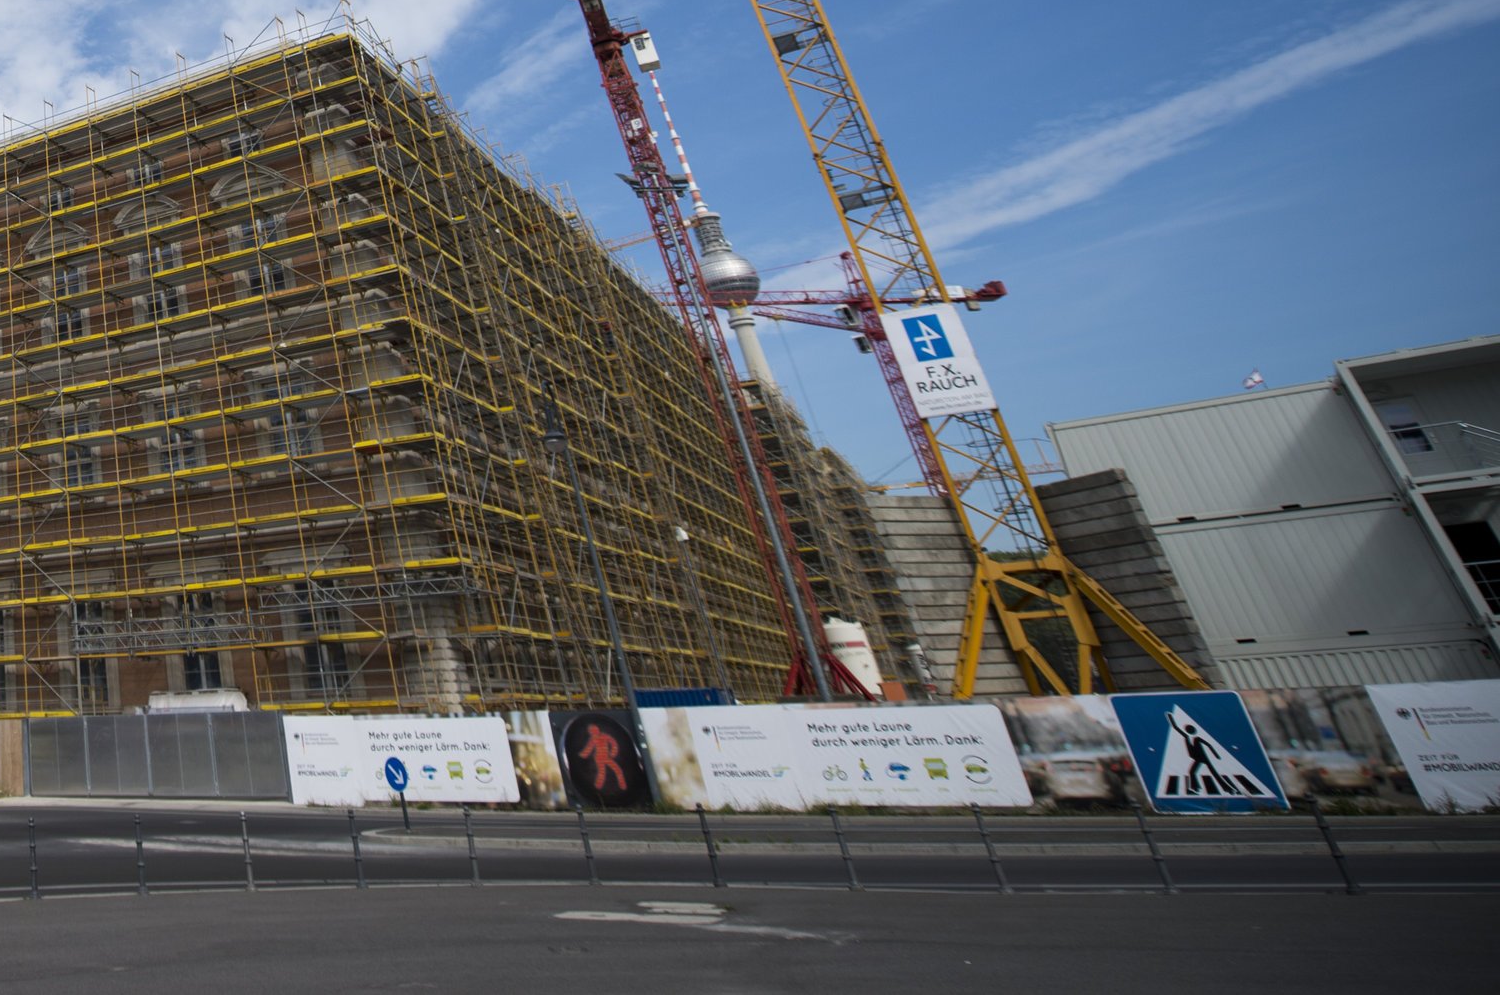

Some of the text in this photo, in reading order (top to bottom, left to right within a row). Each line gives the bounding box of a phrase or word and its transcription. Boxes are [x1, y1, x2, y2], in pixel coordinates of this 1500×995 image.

[925, 363, 961, 378] F. X.
[916, 374, 978, 393] RAUCH
[368, 730, 442, 742] Mehr gute Laune
[807, 721, 912, 736] Mehr gute Laune
[371, 741, 490, 754] durch weniger Lärm. Dank:
[812, 733, 984, 750] durch weniger Lärm. Dank:
[1417, 753, 1461, 762] ZEIT FÜR
